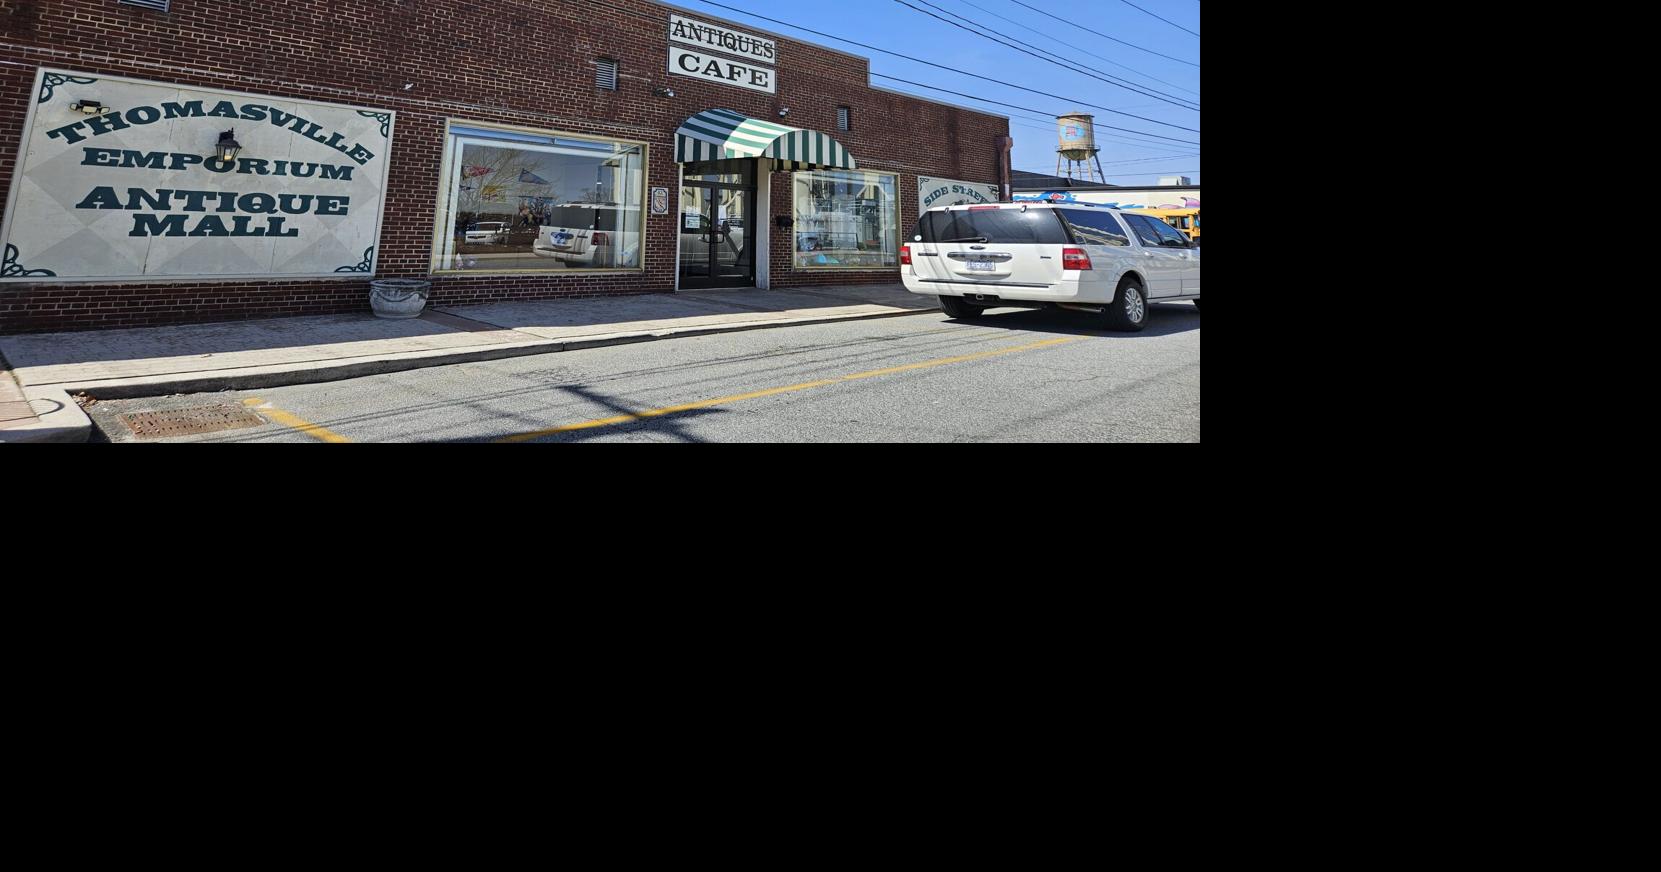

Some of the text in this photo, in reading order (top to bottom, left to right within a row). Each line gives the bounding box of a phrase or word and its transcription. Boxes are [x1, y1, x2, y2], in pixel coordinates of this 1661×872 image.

[672, 20, 773, 58] ANTIQUES
[678, 53, 769, 88] CAFE
[46, 100, 375, 166] THOMASVILLE
[80, 147, 355, 181] EMPORIUM
[75, 186, 350, 215] ANTIQUE
[924, 186, 949, 207] SIDE
[129, 213, 299, 237] MALL
